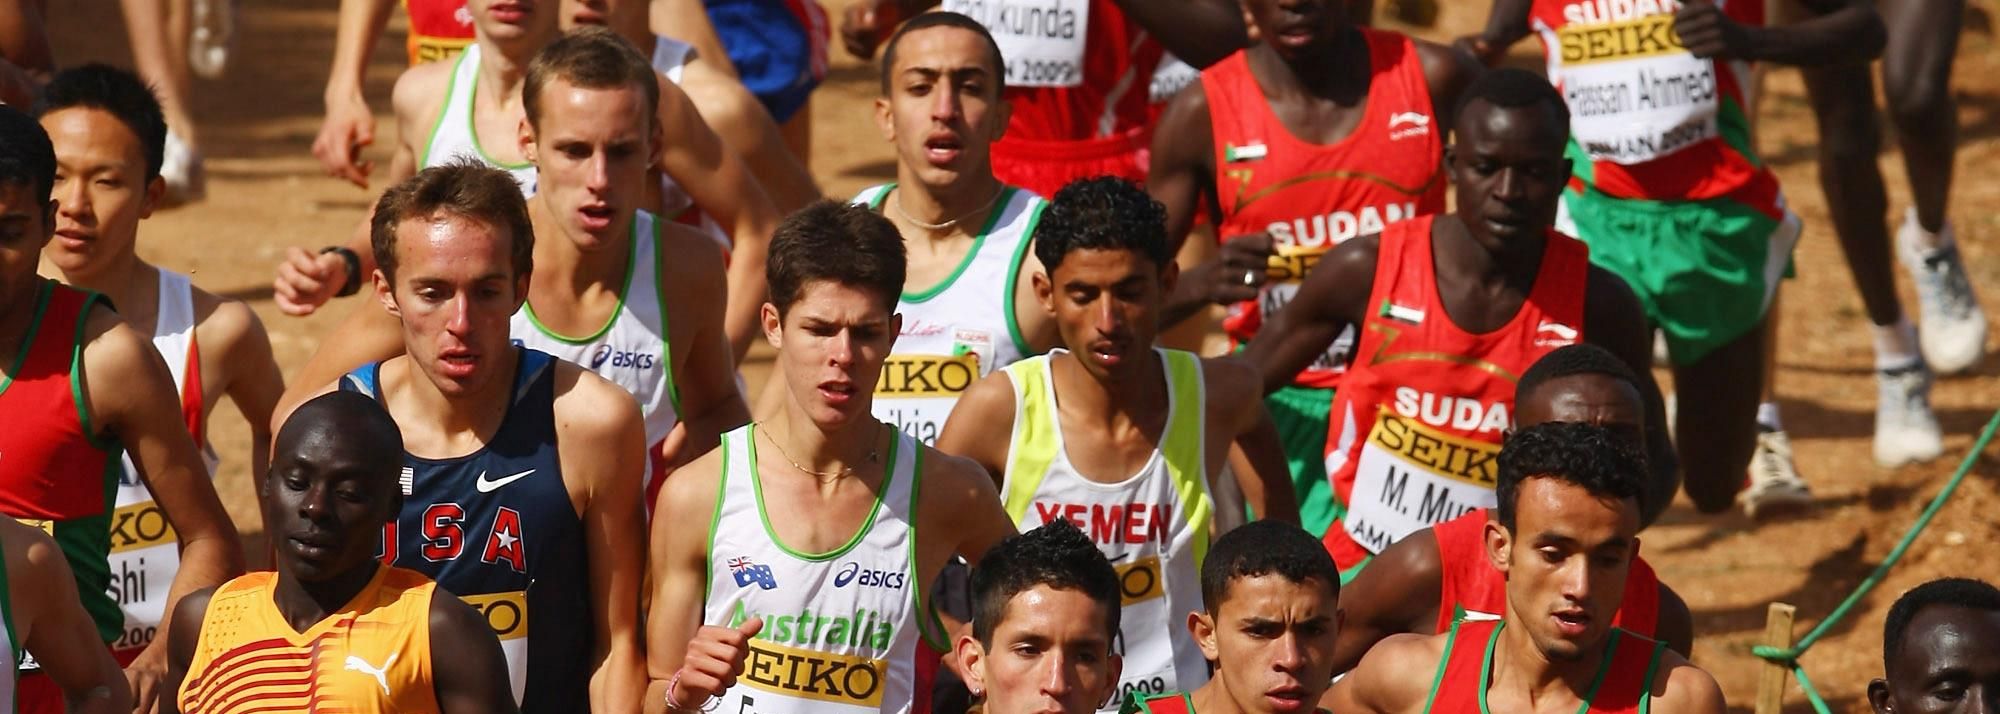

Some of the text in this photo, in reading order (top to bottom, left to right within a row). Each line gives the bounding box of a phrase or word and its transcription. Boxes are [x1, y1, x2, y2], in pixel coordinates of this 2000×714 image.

[1267, 202, 1416, 248] SUDAN
[612, 351, 653, 369] asics
[880, 361, 972, 392] IKO
[1394, 386, 1509, 433] SUDA
[1377, 413, 1499, 482] SEIK
[1035, 503, 1173, 545] YEMEN
[858, 568, 905, 590] asics
[727, 598, 893, 651] Australia
[736, 645, 879, 700] EIKO
